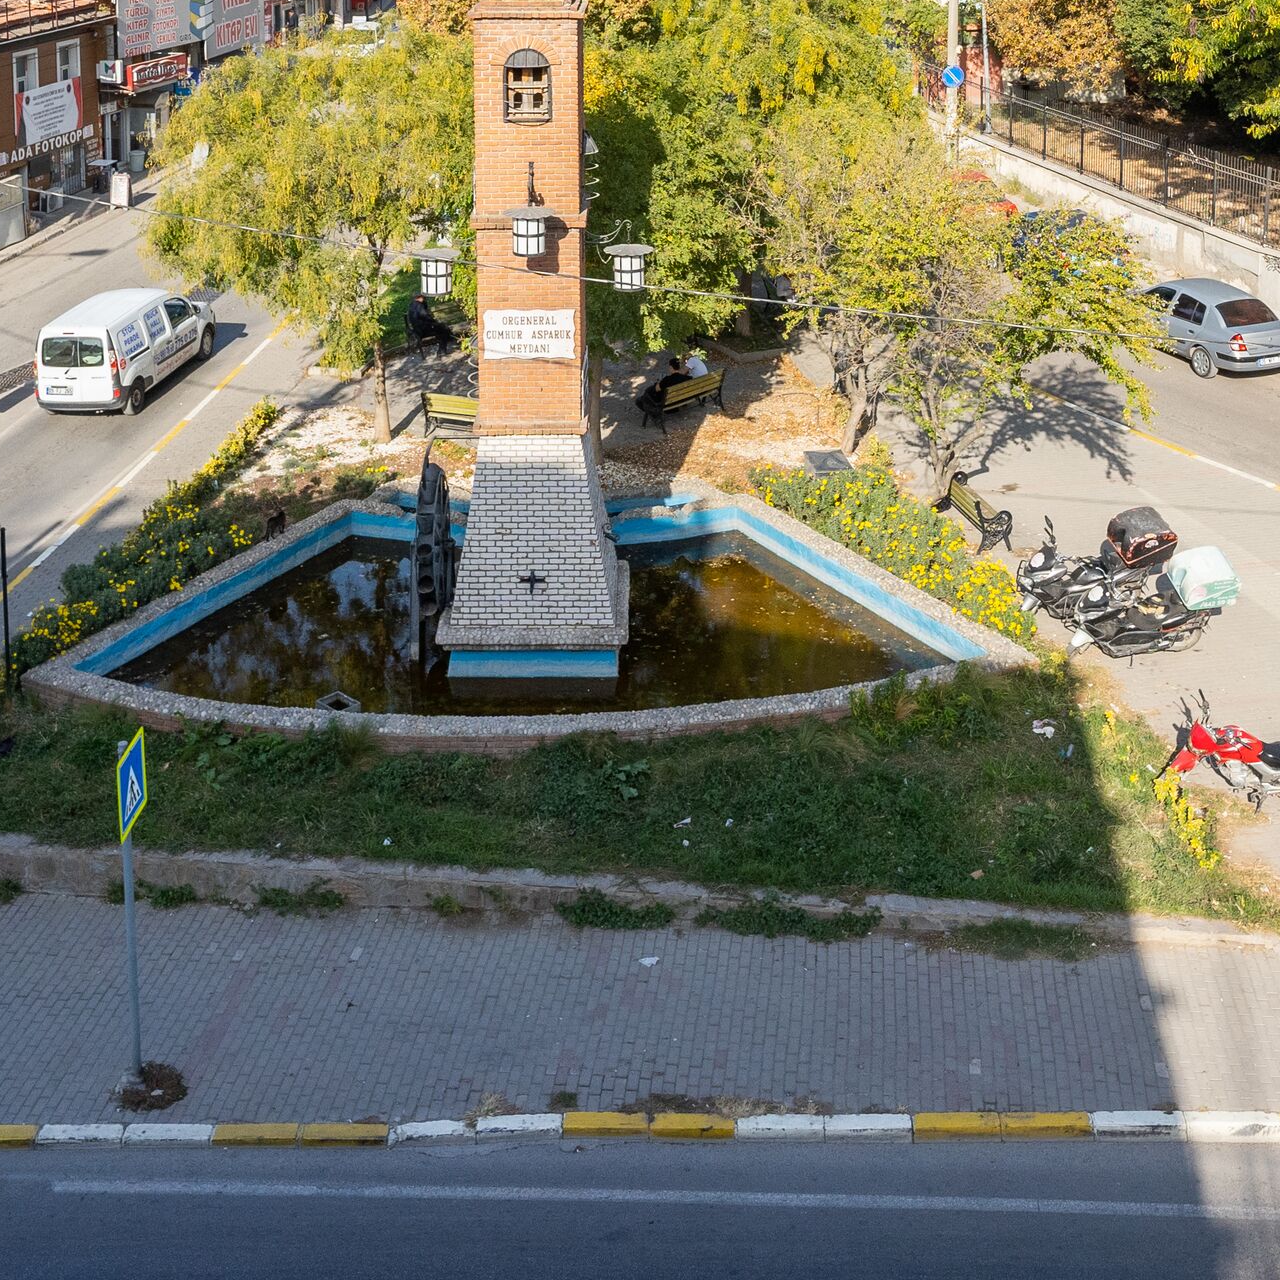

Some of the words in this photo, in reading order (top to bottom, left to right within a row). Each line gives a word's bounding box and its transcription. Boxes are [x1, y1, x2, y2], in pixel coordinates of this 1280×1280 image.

[125, 31, 151, 45] ALINIR
[10, 146, 33, 164] ADA
[146, 308, 159, 320] BUCA
[501, 315, 557, 326] ORGENERAL
[121, 324, 135, 337] STOR
[486, 330, 523, 340] CUMHUR
[531, 329, 572, 340] ASPARUK
[124, 333, 140, 346] PERDE
[125, 341, 144, 356] YIKAMA
[509, 343, 551, 354] MEYDANI
